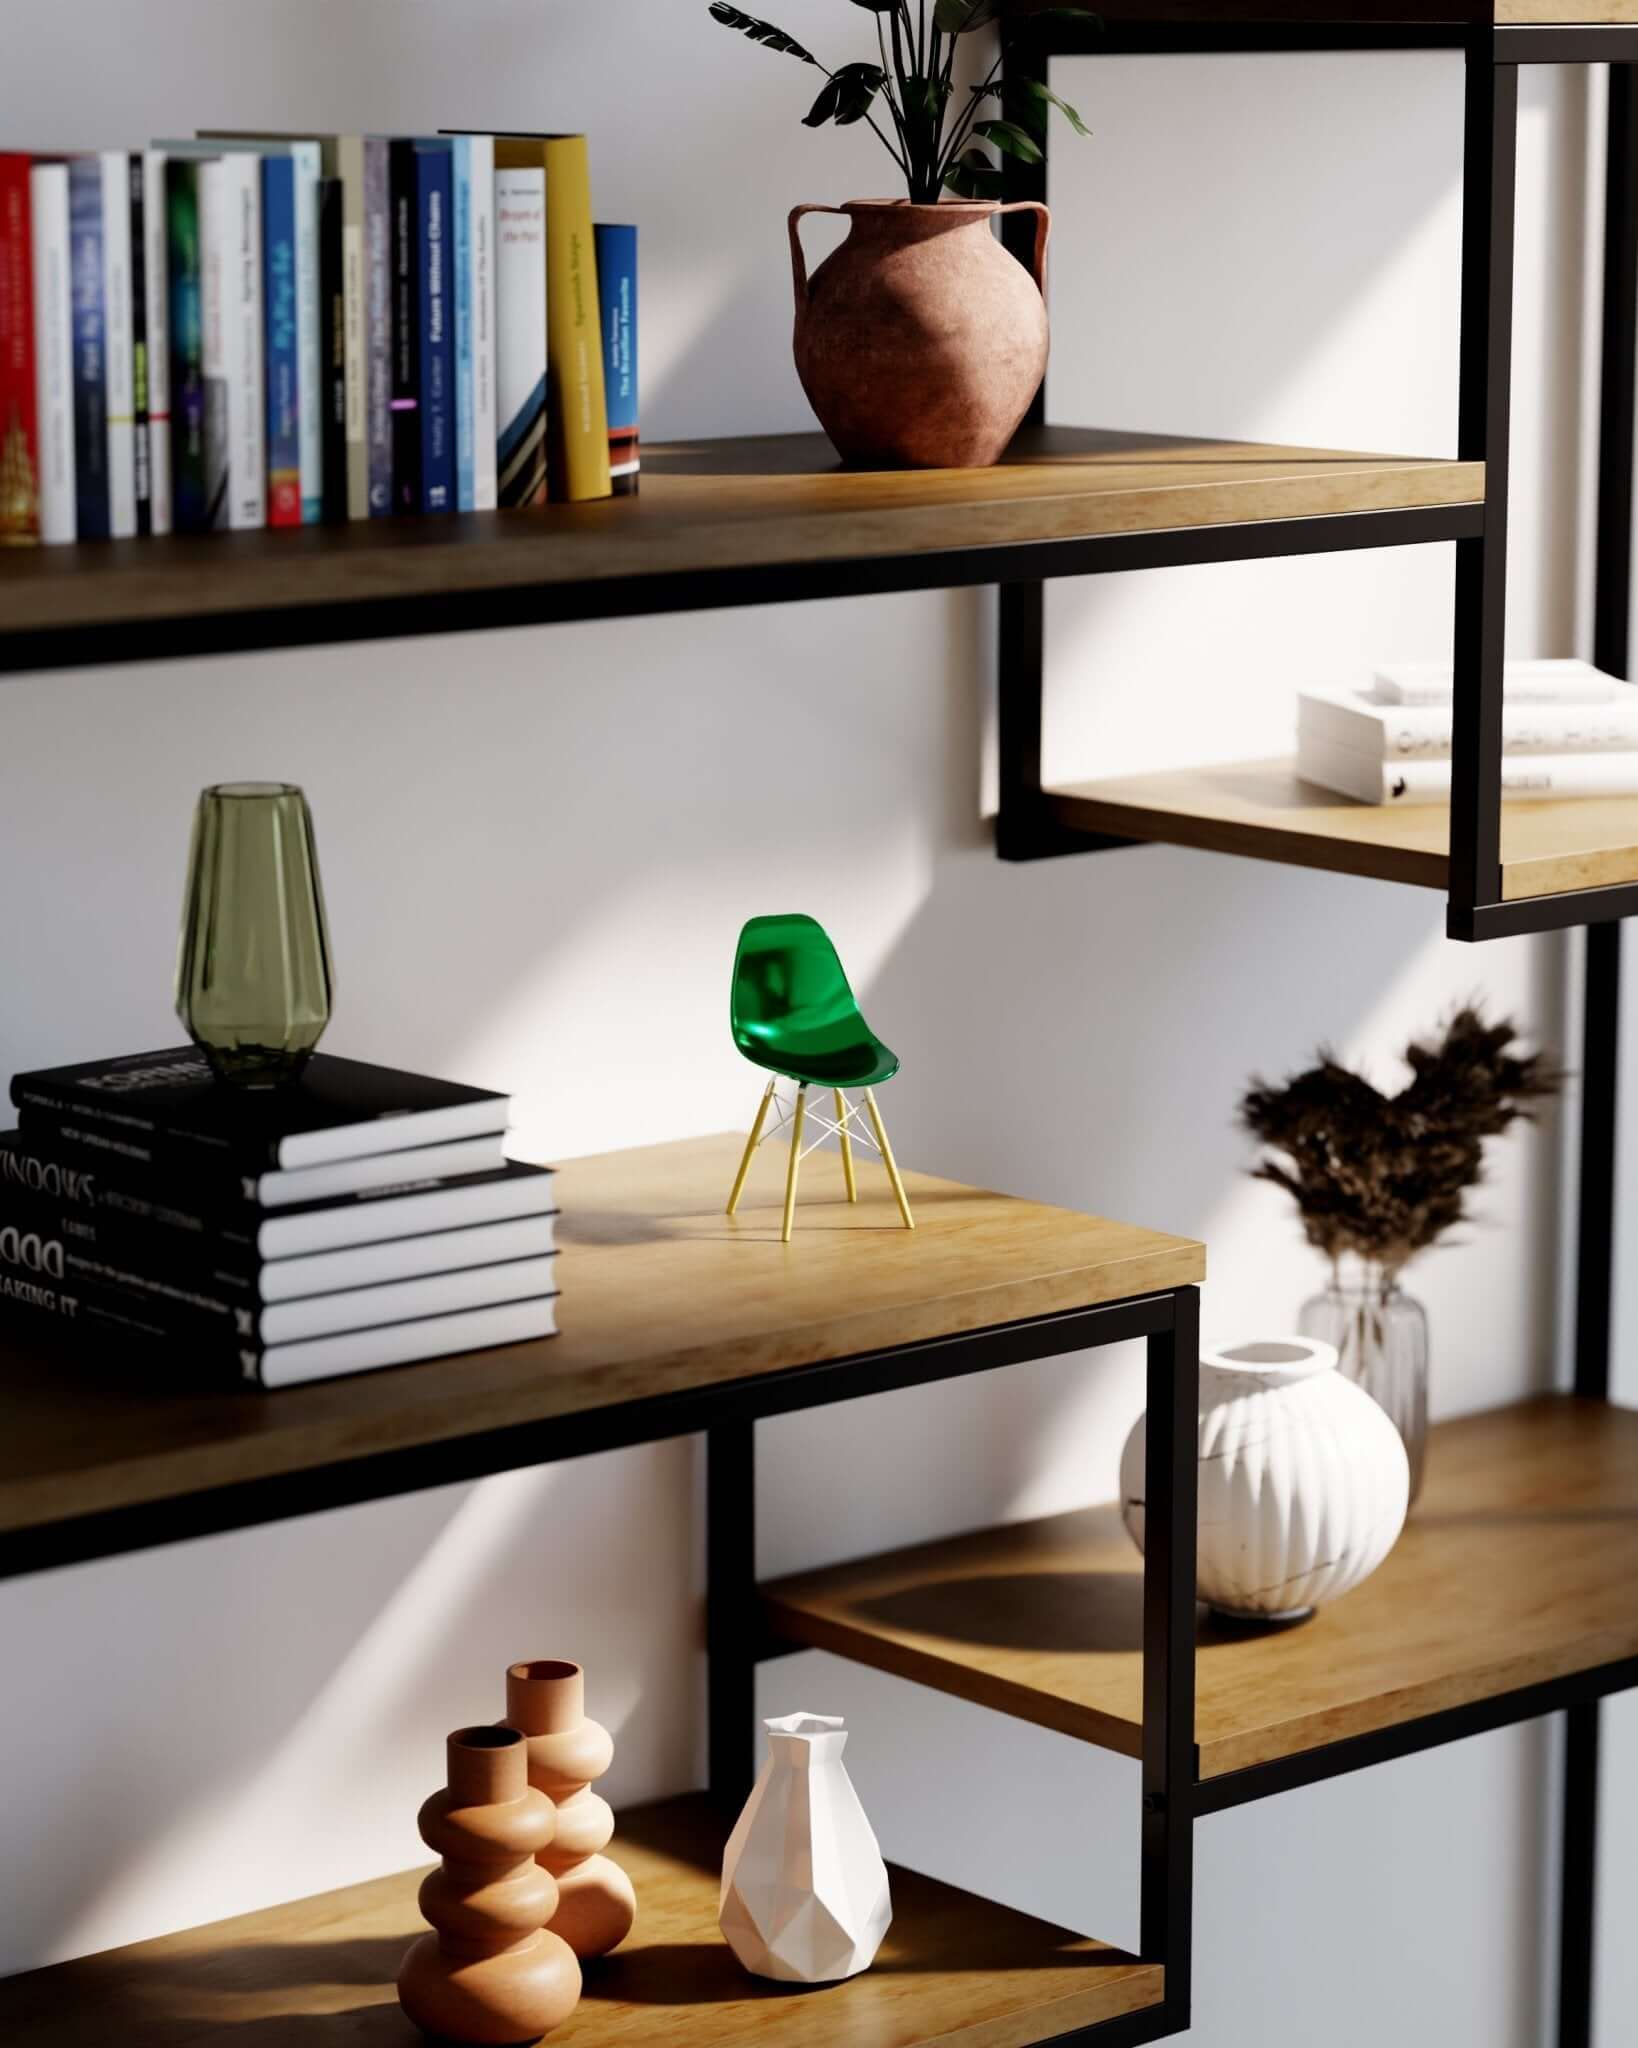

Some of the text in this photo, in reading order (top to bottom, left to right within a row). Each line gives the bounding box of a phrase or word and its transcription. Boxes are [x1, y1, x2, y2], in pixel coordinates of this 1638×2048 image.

[428, 191, 443, 343] Future Without Chains
[619, 277, 631, 398] The Brazilian Favorite
[0, 1273, 56, 1310] AKING
[60, 1294, 79, 1318] IT
